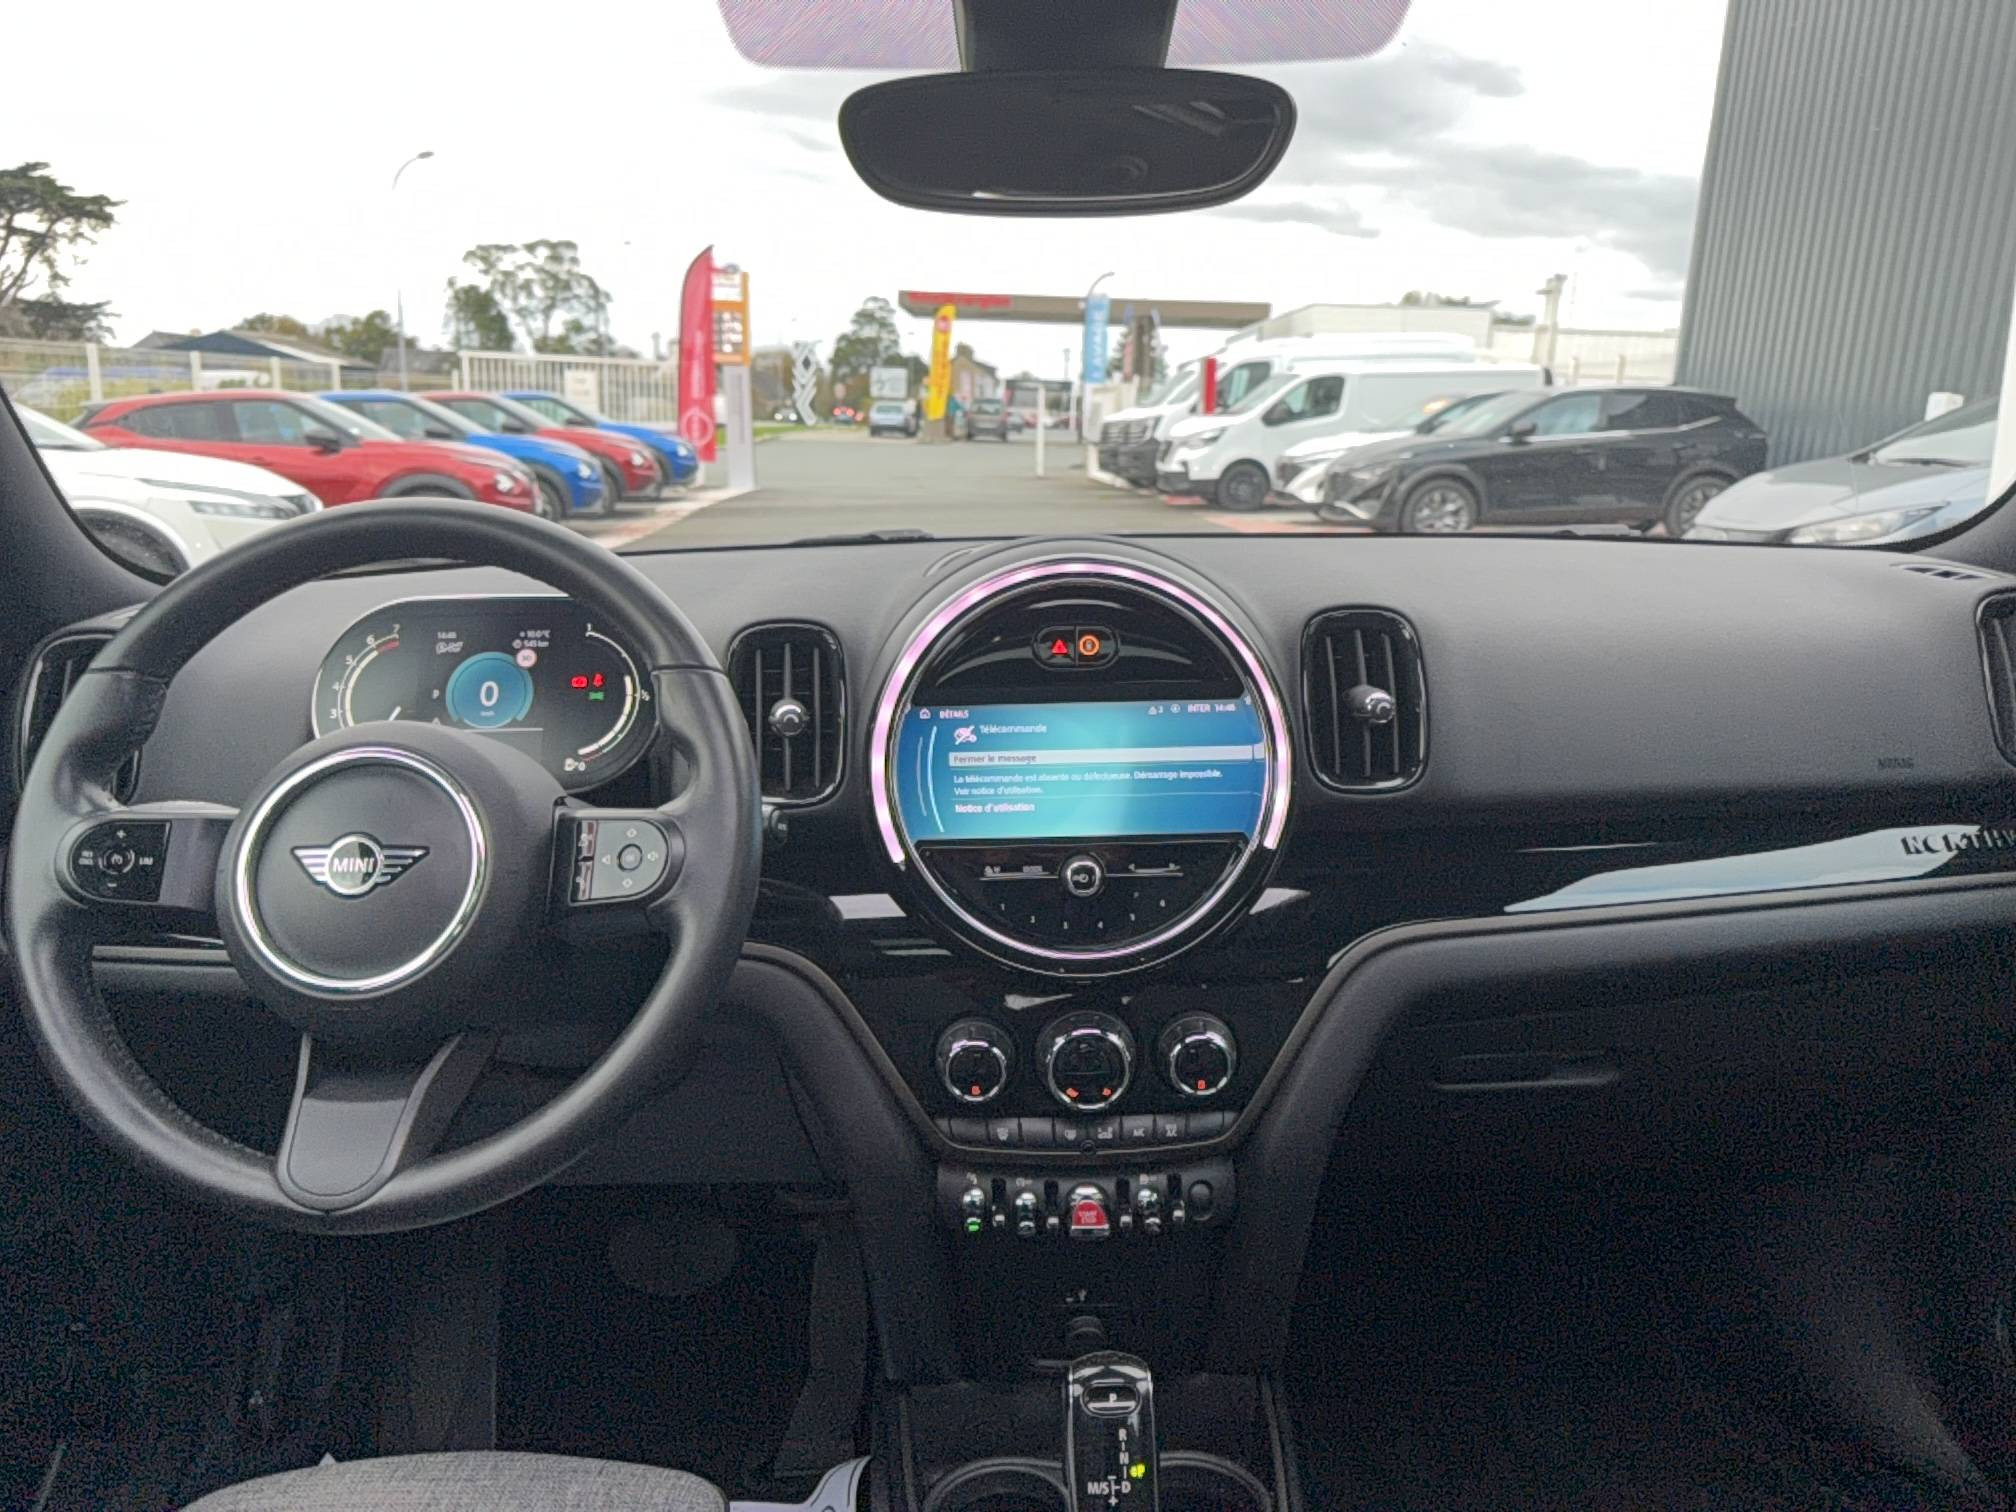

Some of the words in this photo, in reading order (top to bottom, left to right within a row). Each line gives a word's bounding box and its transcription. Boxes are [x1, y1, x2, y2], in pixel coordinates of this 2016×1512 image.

[392, 624, 400, 633] 7
[366, 634, 375, 644] 6
[345, 655, 353, 665] 5
[332, 682, 339, 690] 4
[480, 681, 499, 706] 0
[329, 708, 338, 719] 3
[939, 708, 969, 719] DÉTAILS
[979, 724, 1047, 734] Télécommande
[953, 756, 985, 764] Fermer
[997, 755, 1037, 765] message
[953, 775, 964, 783] La
[965, 773, 1023, 783] télécommande
[1038, 773, 1069, 781] absente
[1133, 770, 1178, 780] Démarrage
[1179, 769, 1223, 779] impossible.
[953, 787, 969, 795] Voir
[971, 787, 995, 795] notice
[954, 803, 983, 813] Notice
[984, 802, 1036, 813] d'utilisation
[333, 857, 375, 873] MINI
[1109, 1393, 1117, 1402] P
[1119, 1429, 1127, 1441] R
[1119, 1452, 1129, 1465] N
[1087, 1481, 1109, 1495] M/S
[1121, 1481, 1131, 1494] D
